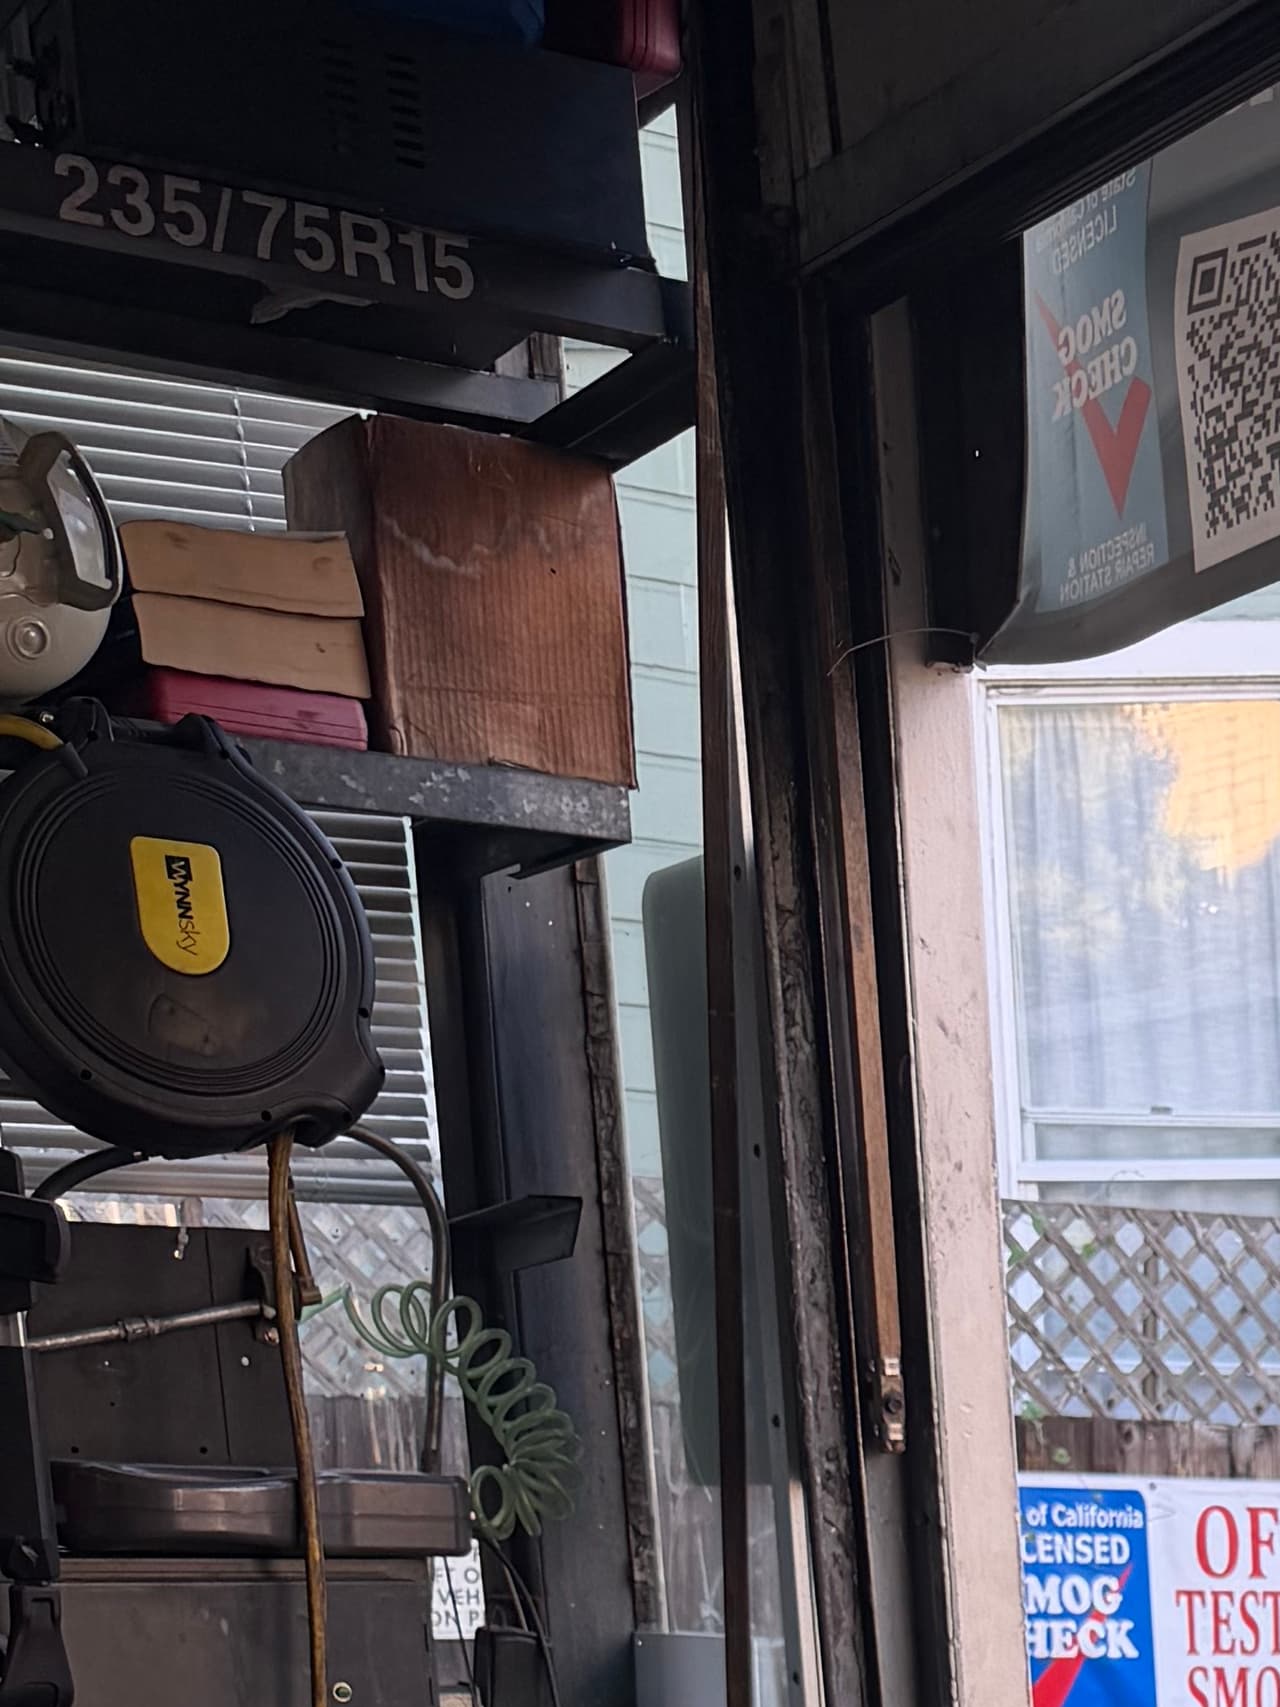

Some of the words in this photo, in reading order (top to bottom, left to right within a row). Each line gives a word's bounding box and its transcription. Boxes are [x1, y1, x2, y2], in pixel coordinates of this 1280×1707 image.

[54, 153, 476, 300] 235/75R15
[1026, 1502, 1047, 1527] of
[1051, 1503, 1145, 1529] California
